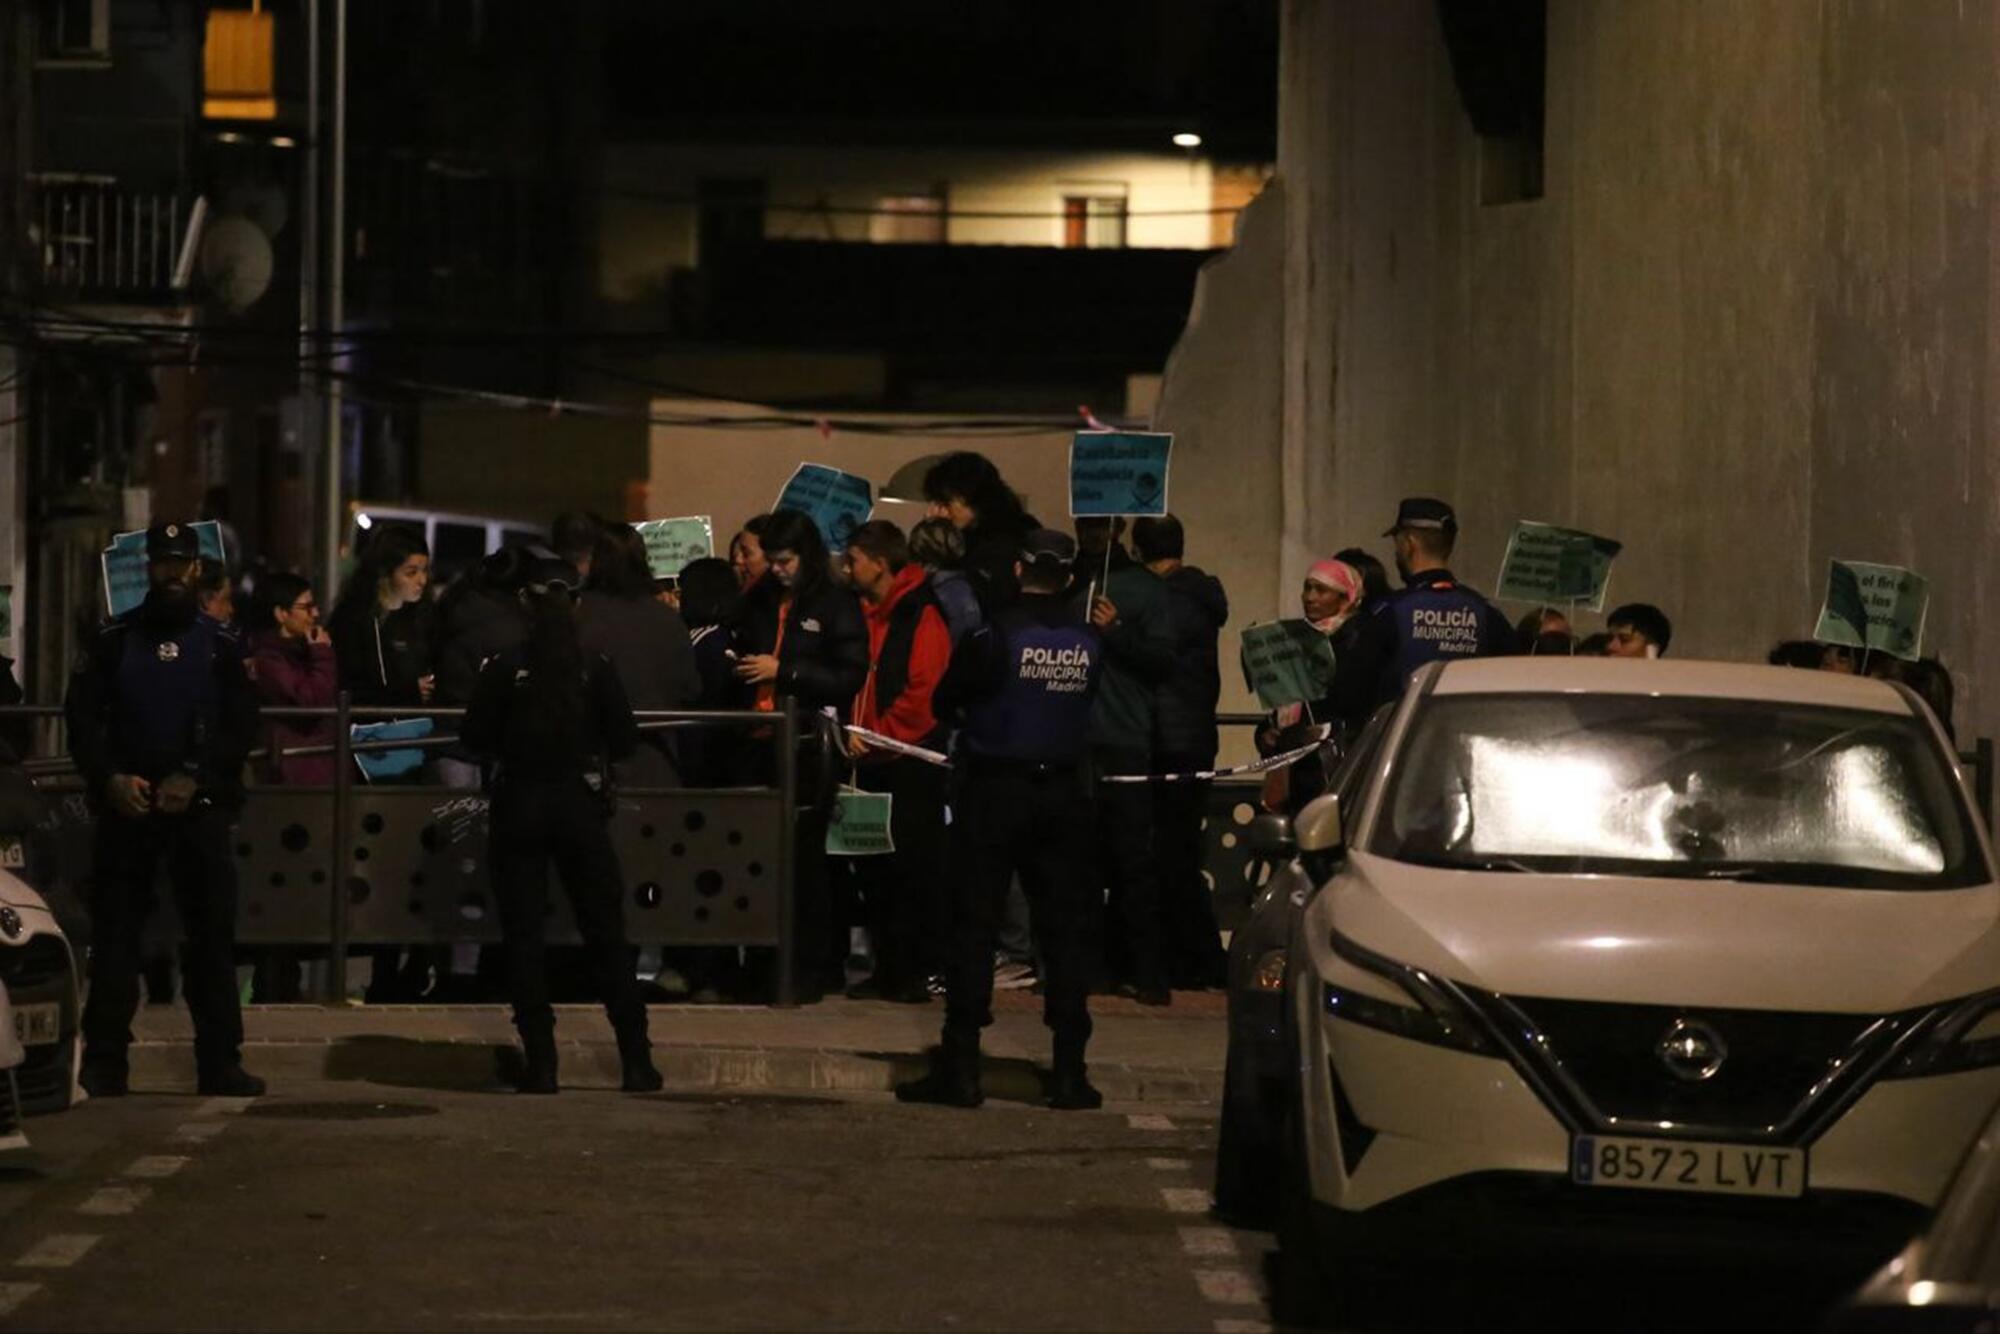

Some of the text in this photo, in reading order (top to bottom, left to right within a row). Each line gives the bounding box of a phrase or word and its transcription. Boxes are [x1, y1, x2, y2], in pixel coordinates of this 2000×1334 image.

[1413, 606, 1477, 628] POLICÍA
[1412, 626, 1477, 641] MUNICIPAL
[1438, 641, 1477, 653] Madrid
[1021, 644, 1089, 666] POLICÍA
[1020, 665, 1088, 680] MUNICIPAL
[1046, 681, 1088, 692] Madrid
[1601, 1144, 1790, 1189] 8572 LVT
